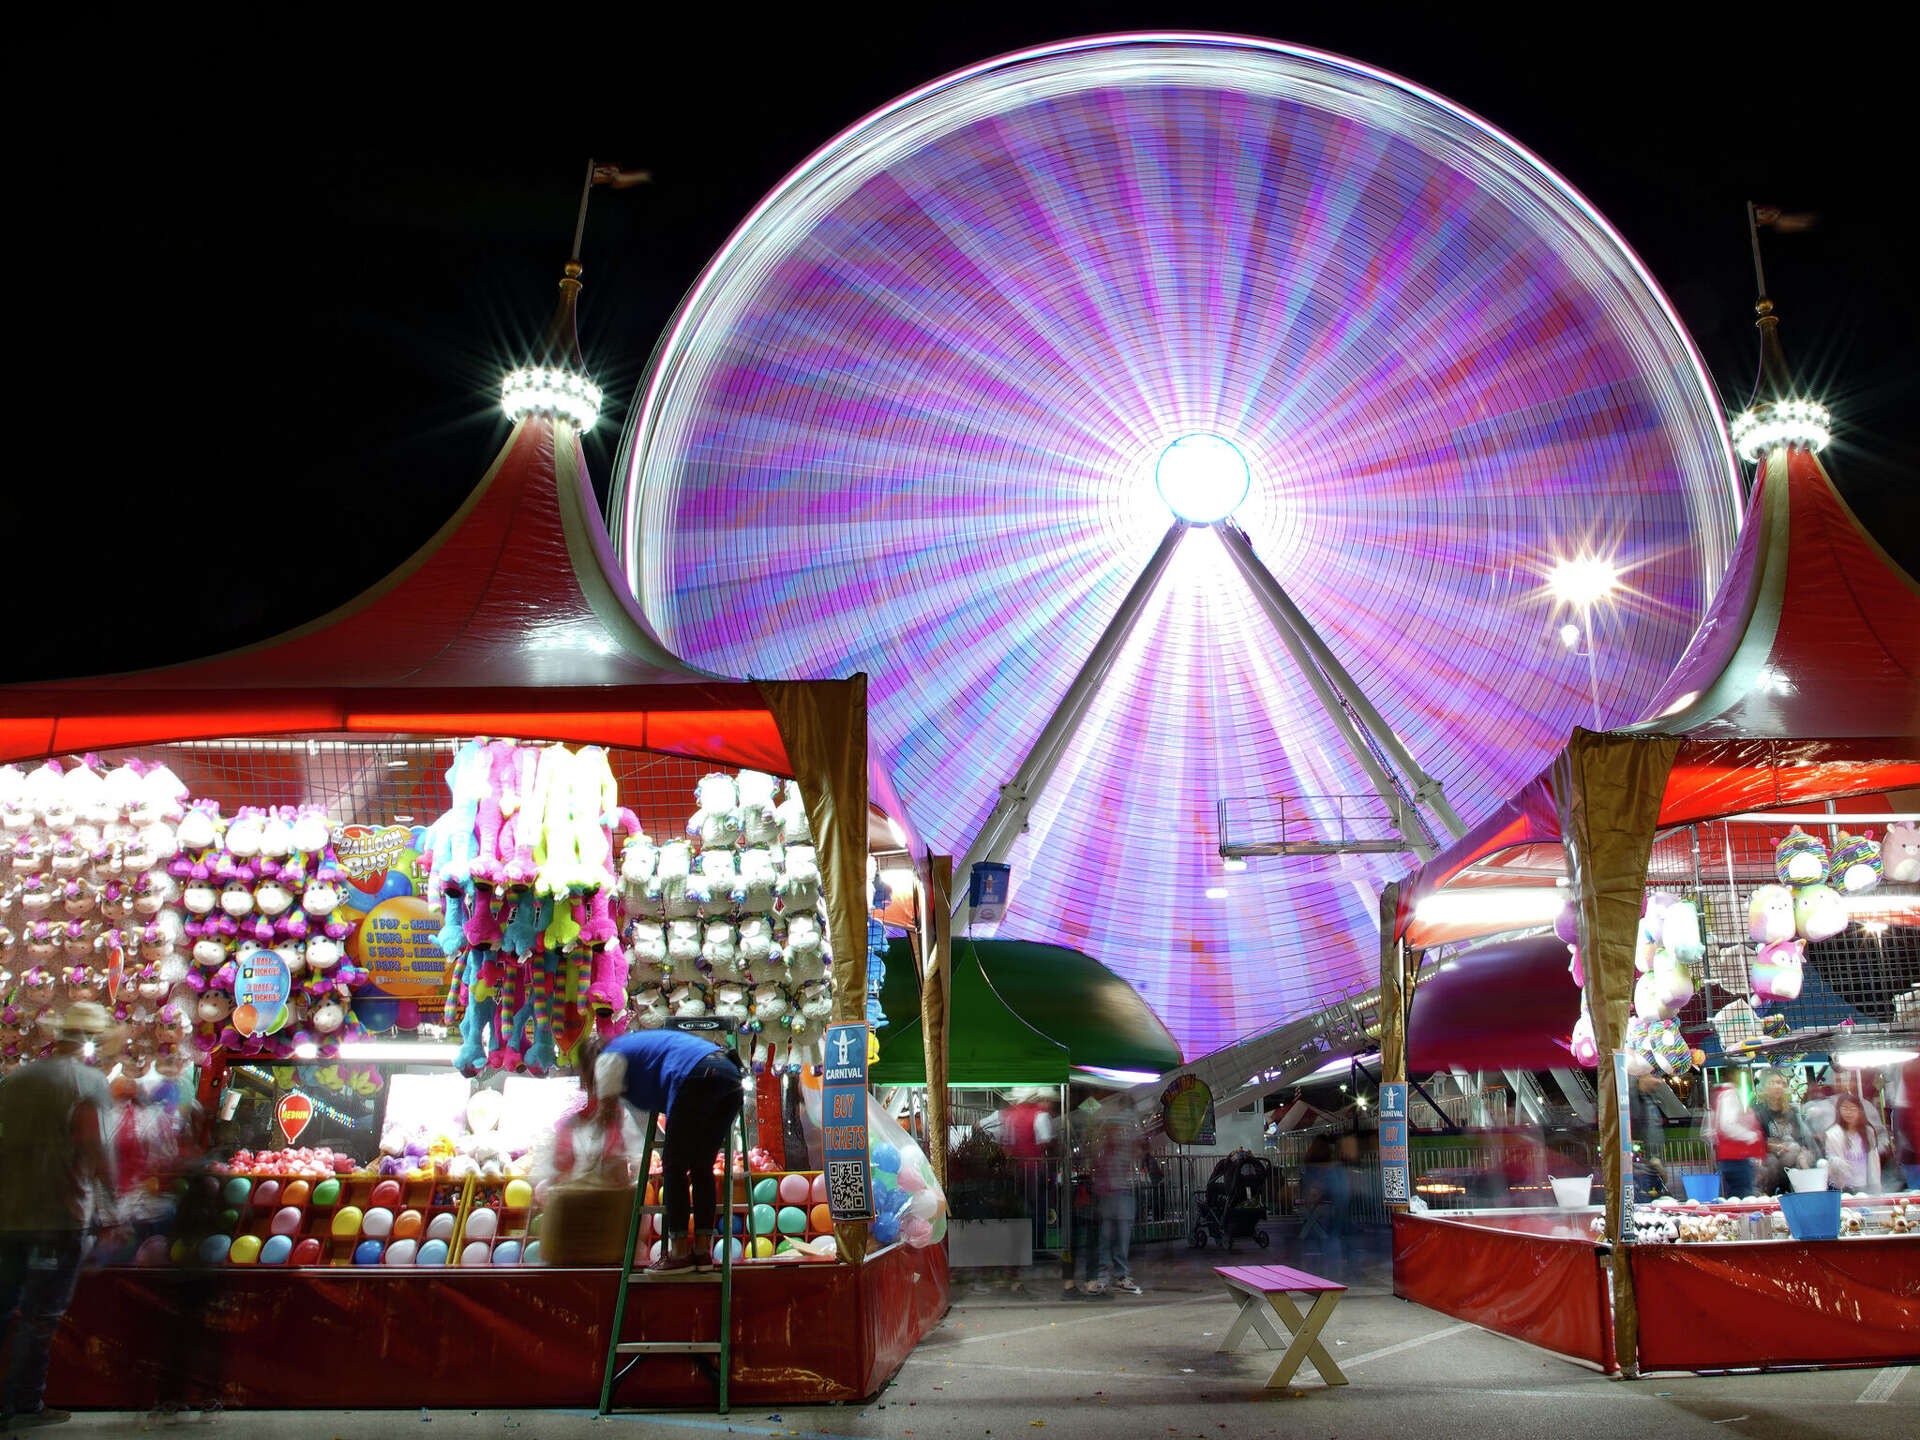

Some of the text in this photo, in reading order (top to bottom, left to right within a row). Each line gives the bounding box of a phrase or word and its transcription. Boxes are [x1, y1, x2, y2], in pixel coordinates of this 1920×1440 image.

[338, 829, 404, 855] BALLOON
[342, 848, 403, 877] BUST
[826, 1068, 863, 1080] CARNIVAL
[281, 1111, 309, 1119] MEDIUM
[833, 1094, 855, 1118] BUY
[825, 1126, 865, 1151] TICKETS
